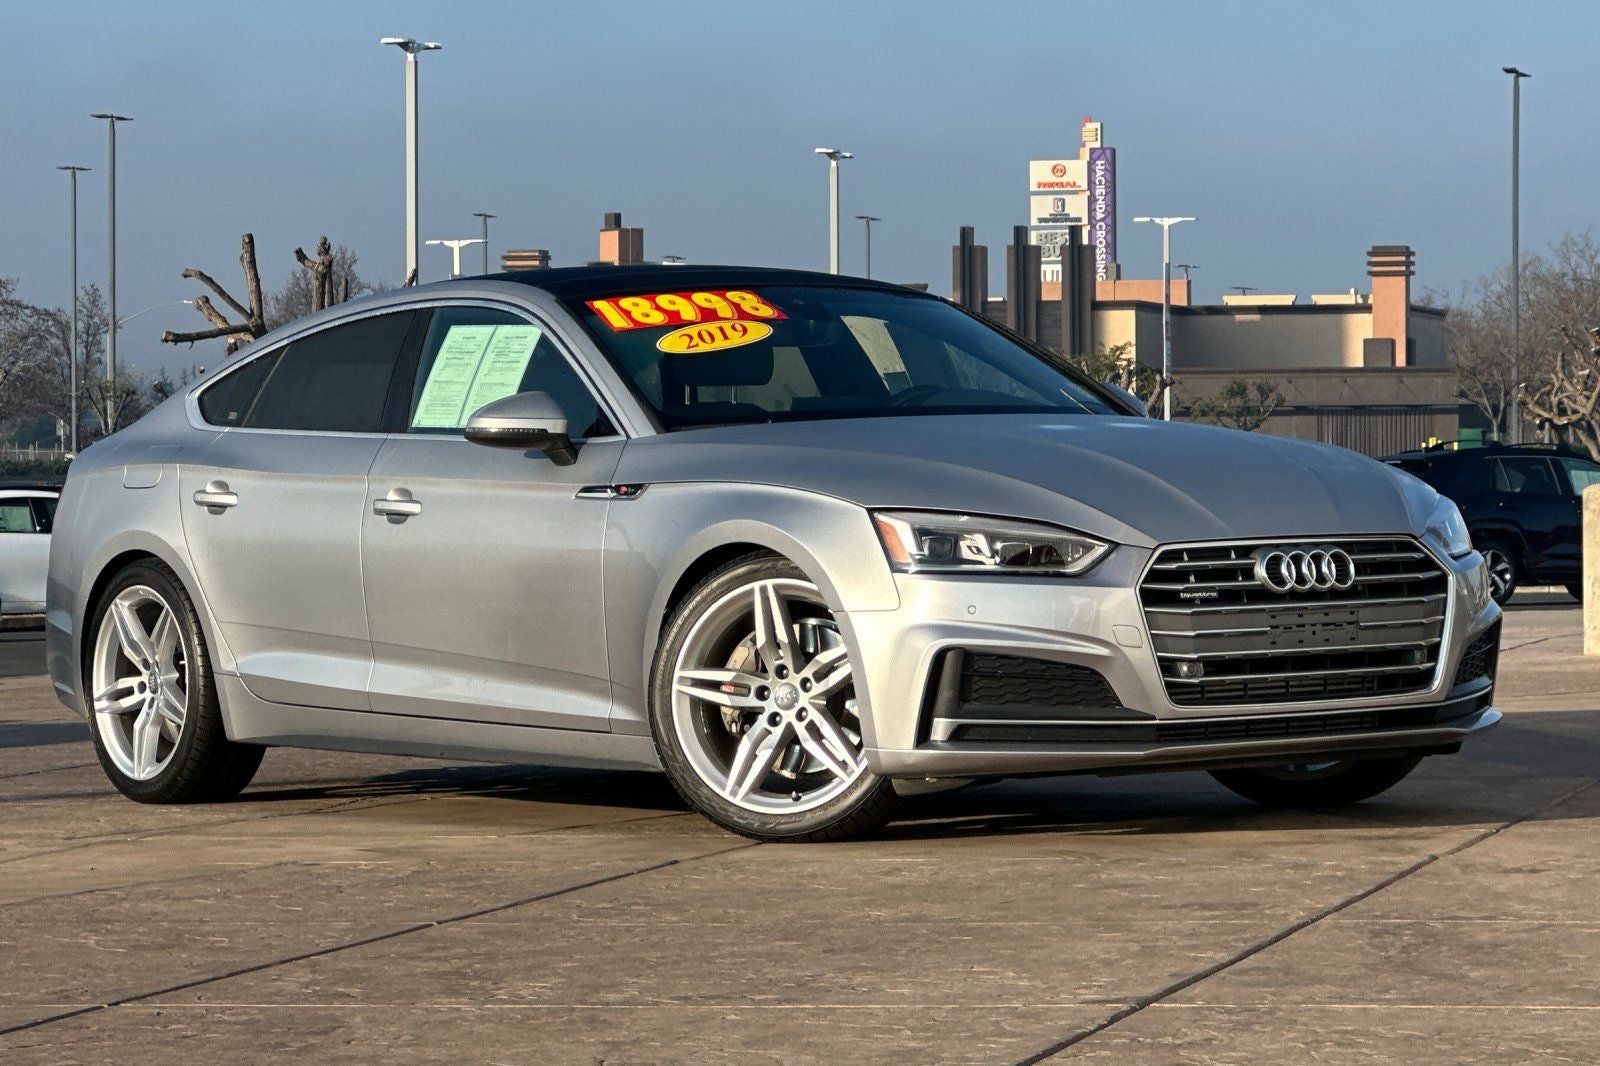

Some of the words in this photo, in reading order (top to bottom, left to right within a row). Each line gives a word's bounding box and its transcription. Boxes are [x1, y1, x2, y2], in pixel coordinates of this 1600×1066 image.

[1095, 160, 1106, 220] HACIENDA
[1036, 232, 1069, 245] BES
[1041, 243, 1061, 258] BU
[1095, 222, 1106, 281] CROSSING
[593, 291, 776, 328] 18998
[679, 322, 749, 350] 2019
